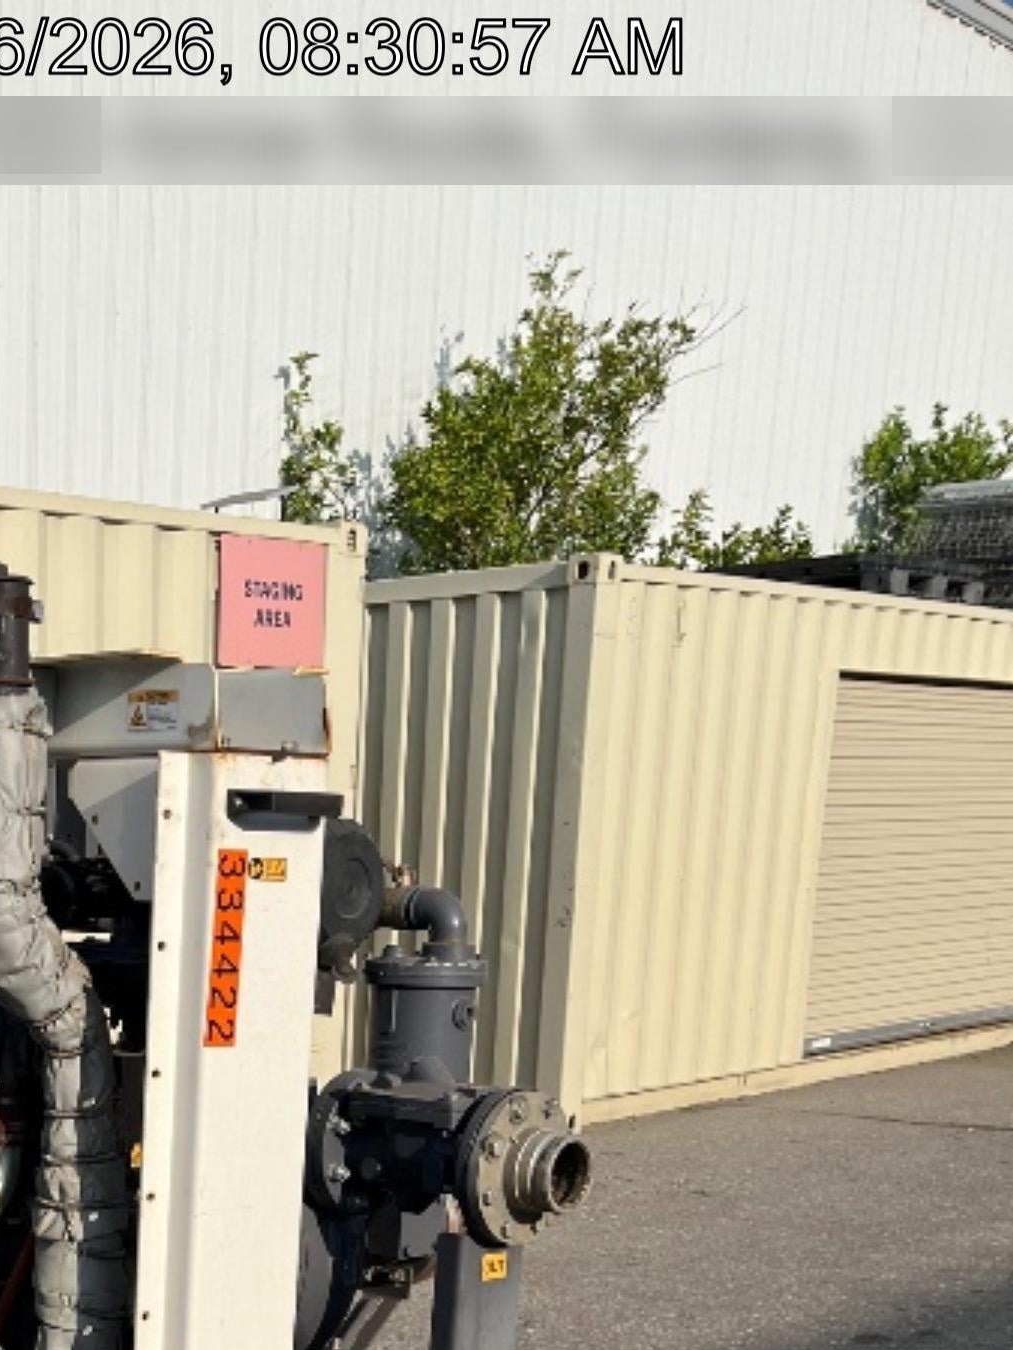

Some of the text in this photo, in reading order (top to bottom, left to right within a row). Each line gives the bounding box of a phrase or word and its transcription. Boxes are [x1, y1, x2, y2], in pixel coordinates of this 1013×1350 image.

[244, 579, 303, 601] STAGING
[253, 608, 292, 628] AREA
[207, 853, 247, 1042] 334422
